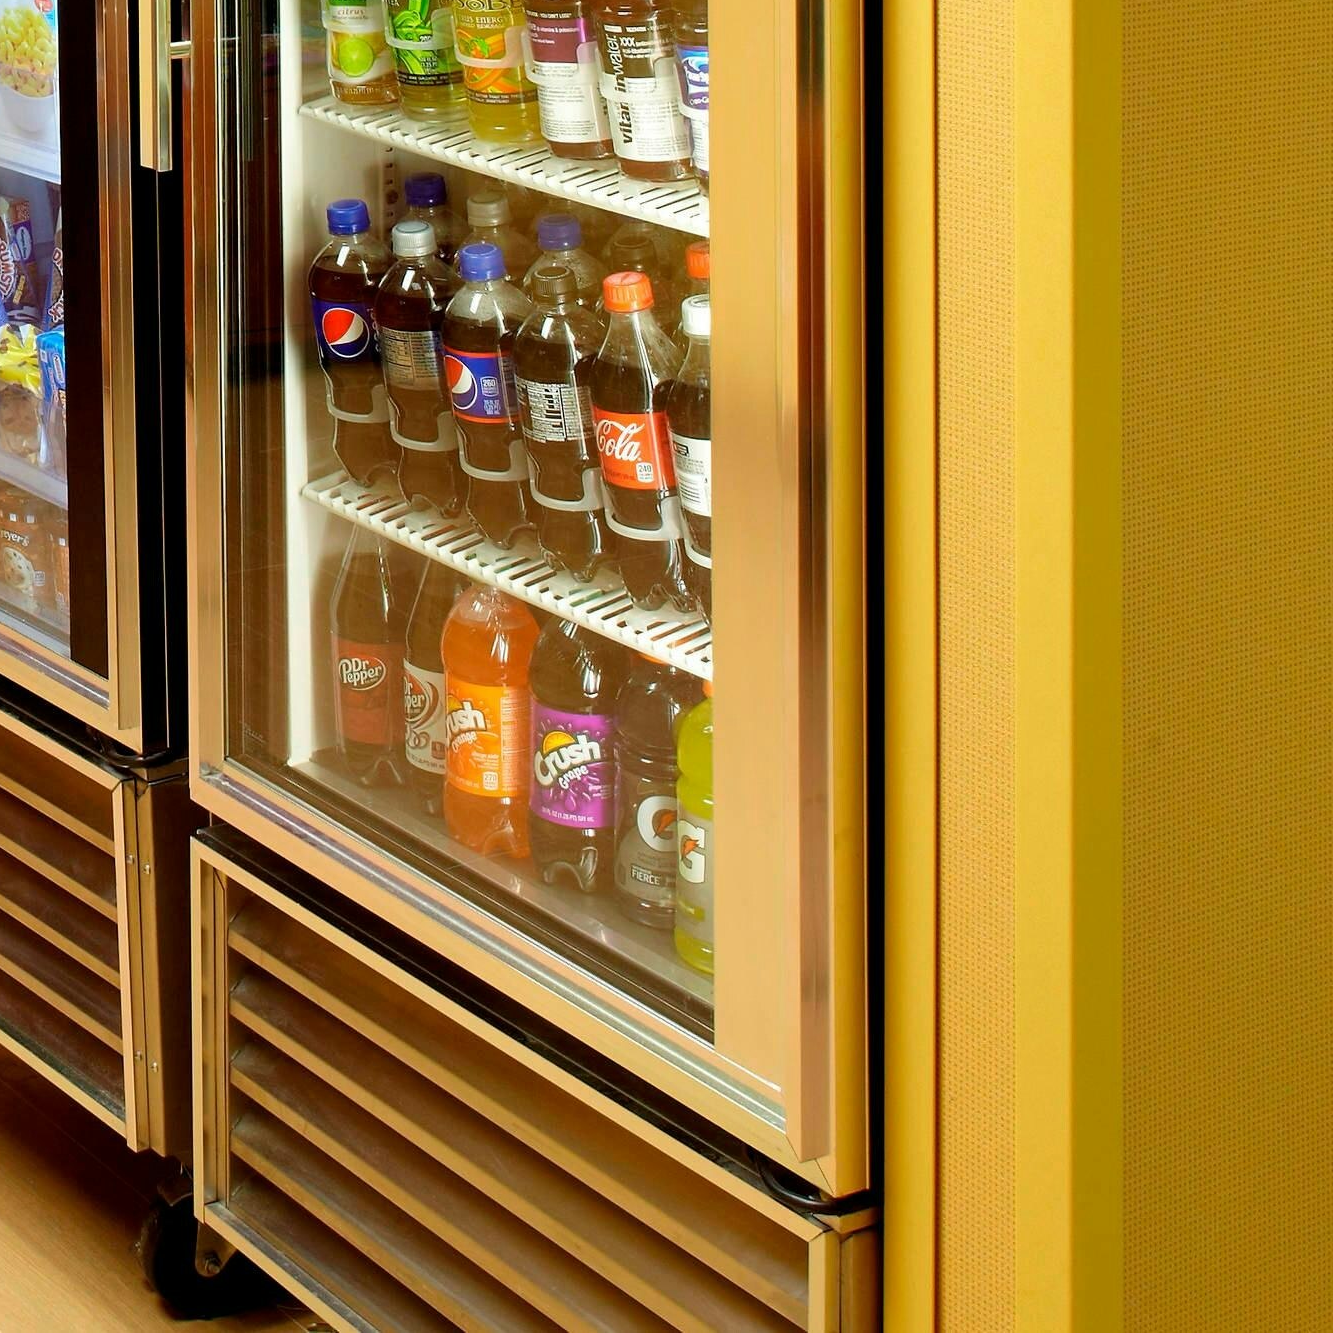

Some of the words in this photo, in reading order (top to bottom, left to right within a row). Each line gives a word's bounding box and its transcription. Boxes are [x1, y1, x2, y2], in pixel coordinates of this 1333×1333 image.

[595, 418, 644, 463] Cola
[638, 464, 653, 474] 240
[339, 659, 383, 686] Pepper
[351, 657, 370, 672] Dr
[451, 731, 478, 754] Orange
[534, 733, 601, 787] Crush
[558, 765, 590, 790] Grape
[678, 819, 705, 884] G
[631, 868, 660, 886] FIERCE
